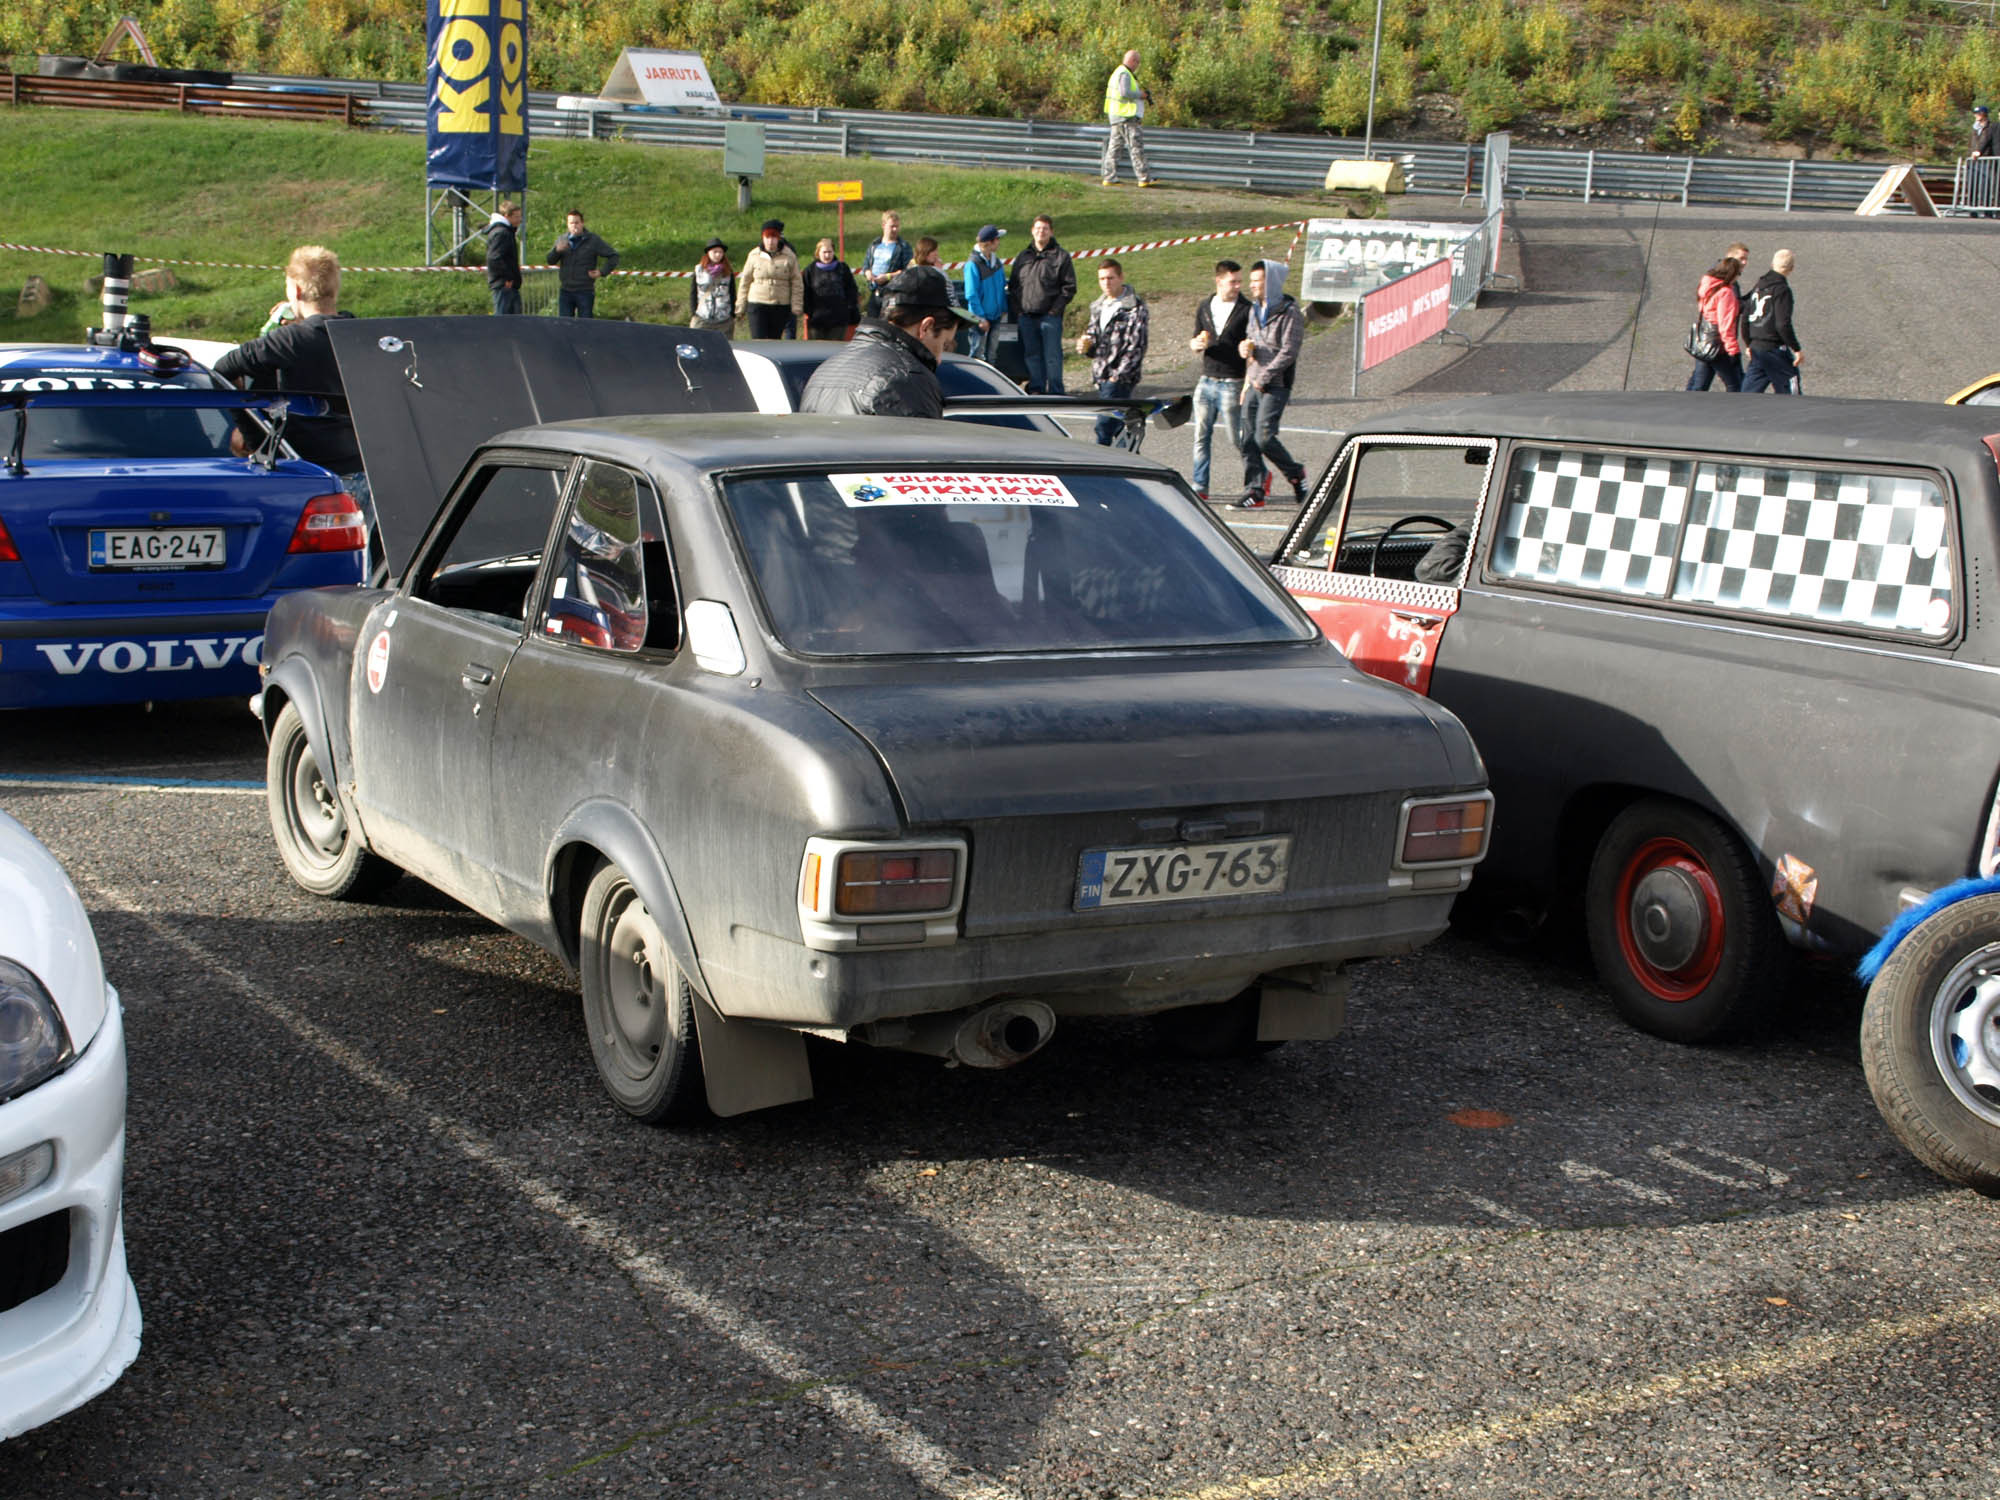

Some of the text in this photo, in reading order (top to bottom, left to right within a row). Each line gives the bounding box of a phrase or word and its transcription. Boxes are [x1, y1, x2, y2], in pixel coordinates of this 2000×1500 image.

[437, 0, 491, 133] KO
[499, 0, 524, 135] KO
[645, 67, 702, 80] JARRUTA
[1368, 305, 1408, 339] NISSAN
[882, 475, 1055, 485] KULMAN PENTIN
[891, 484, 1063, 497] PIKNIKKI
[111, 535, 217, 560] EAG-247
[1109, 845, 1278, 898] ZXG-763
[1081, 884, 1100, 898] FIN
